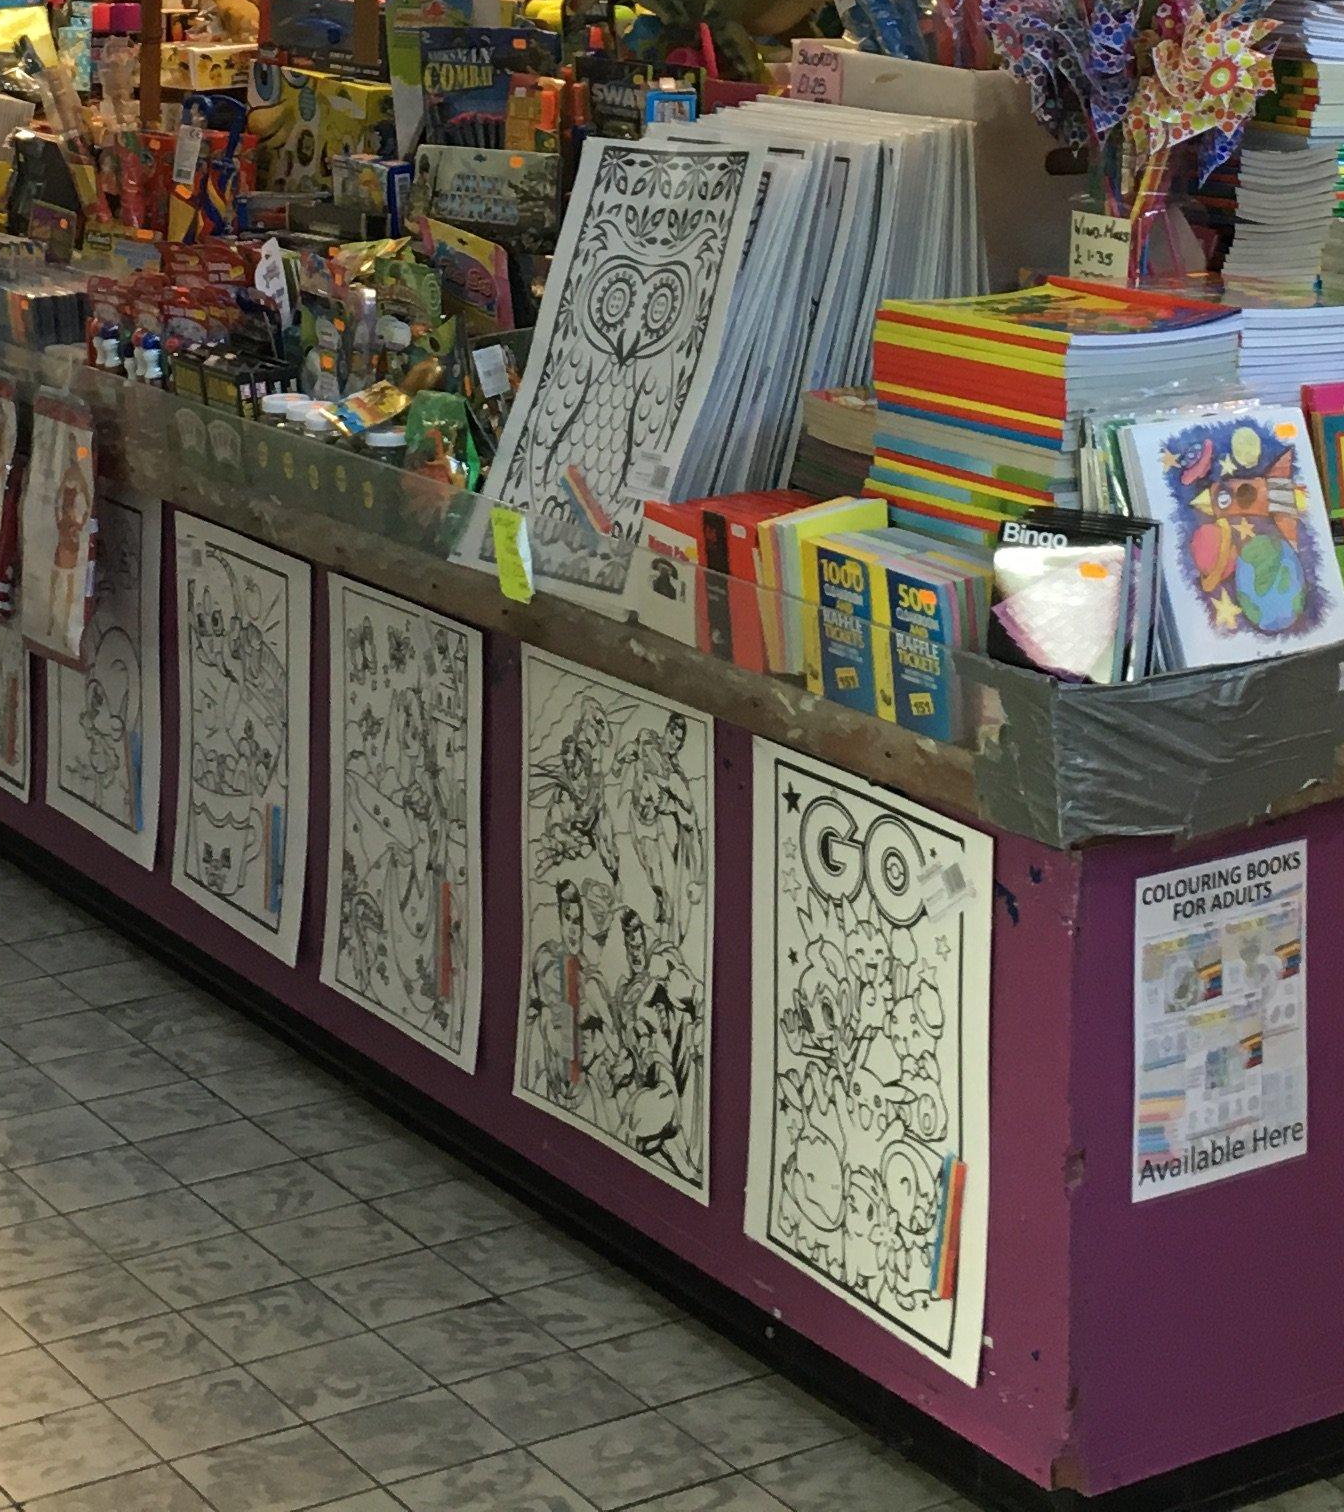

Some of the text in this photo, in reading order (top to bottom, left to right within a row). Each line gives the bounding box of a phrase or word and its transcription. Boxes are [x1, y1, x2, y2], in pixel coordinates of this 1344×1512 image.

[1002, 521, 1069, 549] Bingo
[820, 558, 865, 593] 1000
[895, 631, 940, 660] RAFFLE
[896, 648, 941, 676] TICKETS
[798, 794, 928, 928] GO
[1141, 850, 1302, 906] COLOURING BOOKS
[1172, 880, 1274, 921] FOR ADULTS
[1137, 1120, 1305, 1187] Available Here
